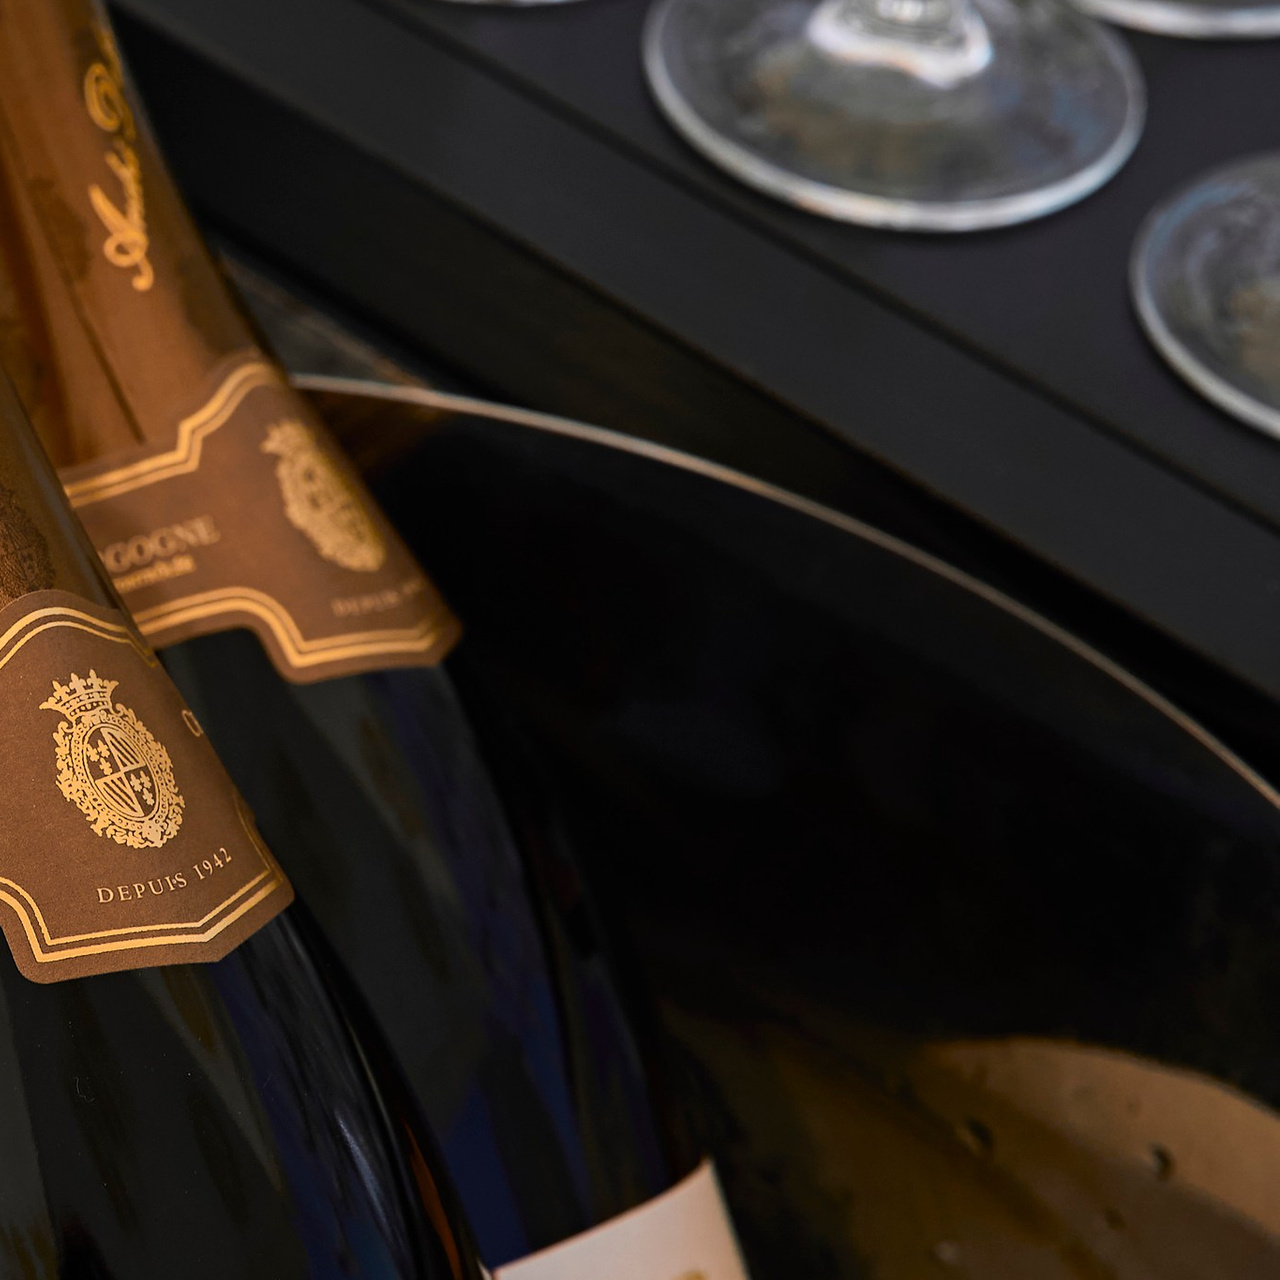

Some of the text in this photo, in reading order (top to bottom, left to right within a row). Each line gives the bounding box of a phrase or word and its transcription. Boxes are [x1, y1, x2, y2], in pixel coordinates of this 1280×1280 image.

[101, 515, 220, 572] GOGNE
[96, 846, 233, 904] DEPUIS 1942
